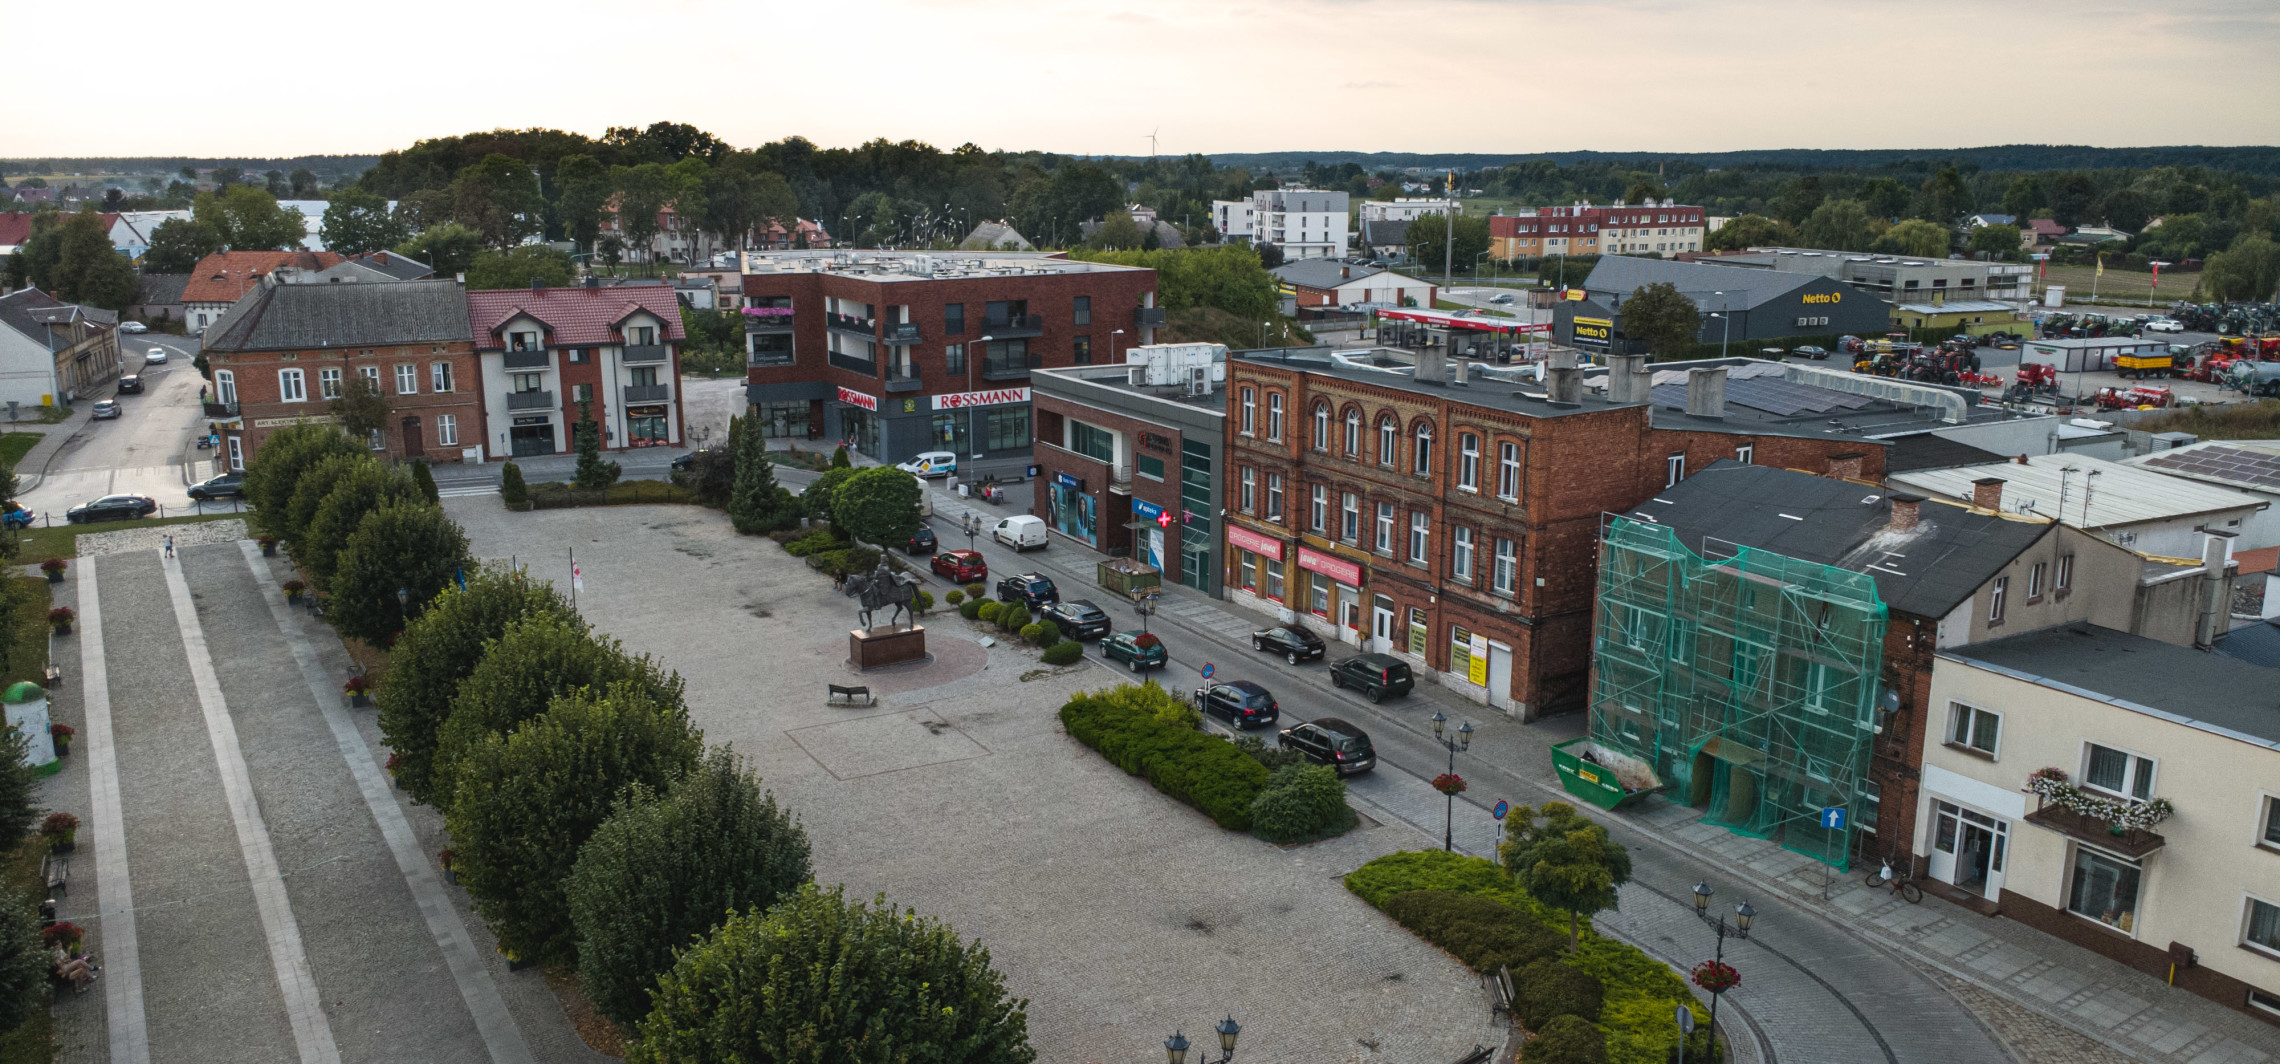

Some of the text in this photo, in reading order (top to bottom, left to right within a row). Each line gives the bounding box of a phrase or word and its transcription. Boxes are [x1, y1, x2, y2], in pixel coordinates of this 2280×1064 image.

[1802, 293, 1830, 303] Netto
[1576, 326, 1598, 336] Netto
[838, 388, 876, 410] ROSSMANN
[941, 389, 1023, 408] ROSSMANN
[1142, 506, 1157, 515] apteka
[1229, 531, 1276, 553] DROGERIE jawa
[1300, 551, 1358, 580] jawa DROGERIE
